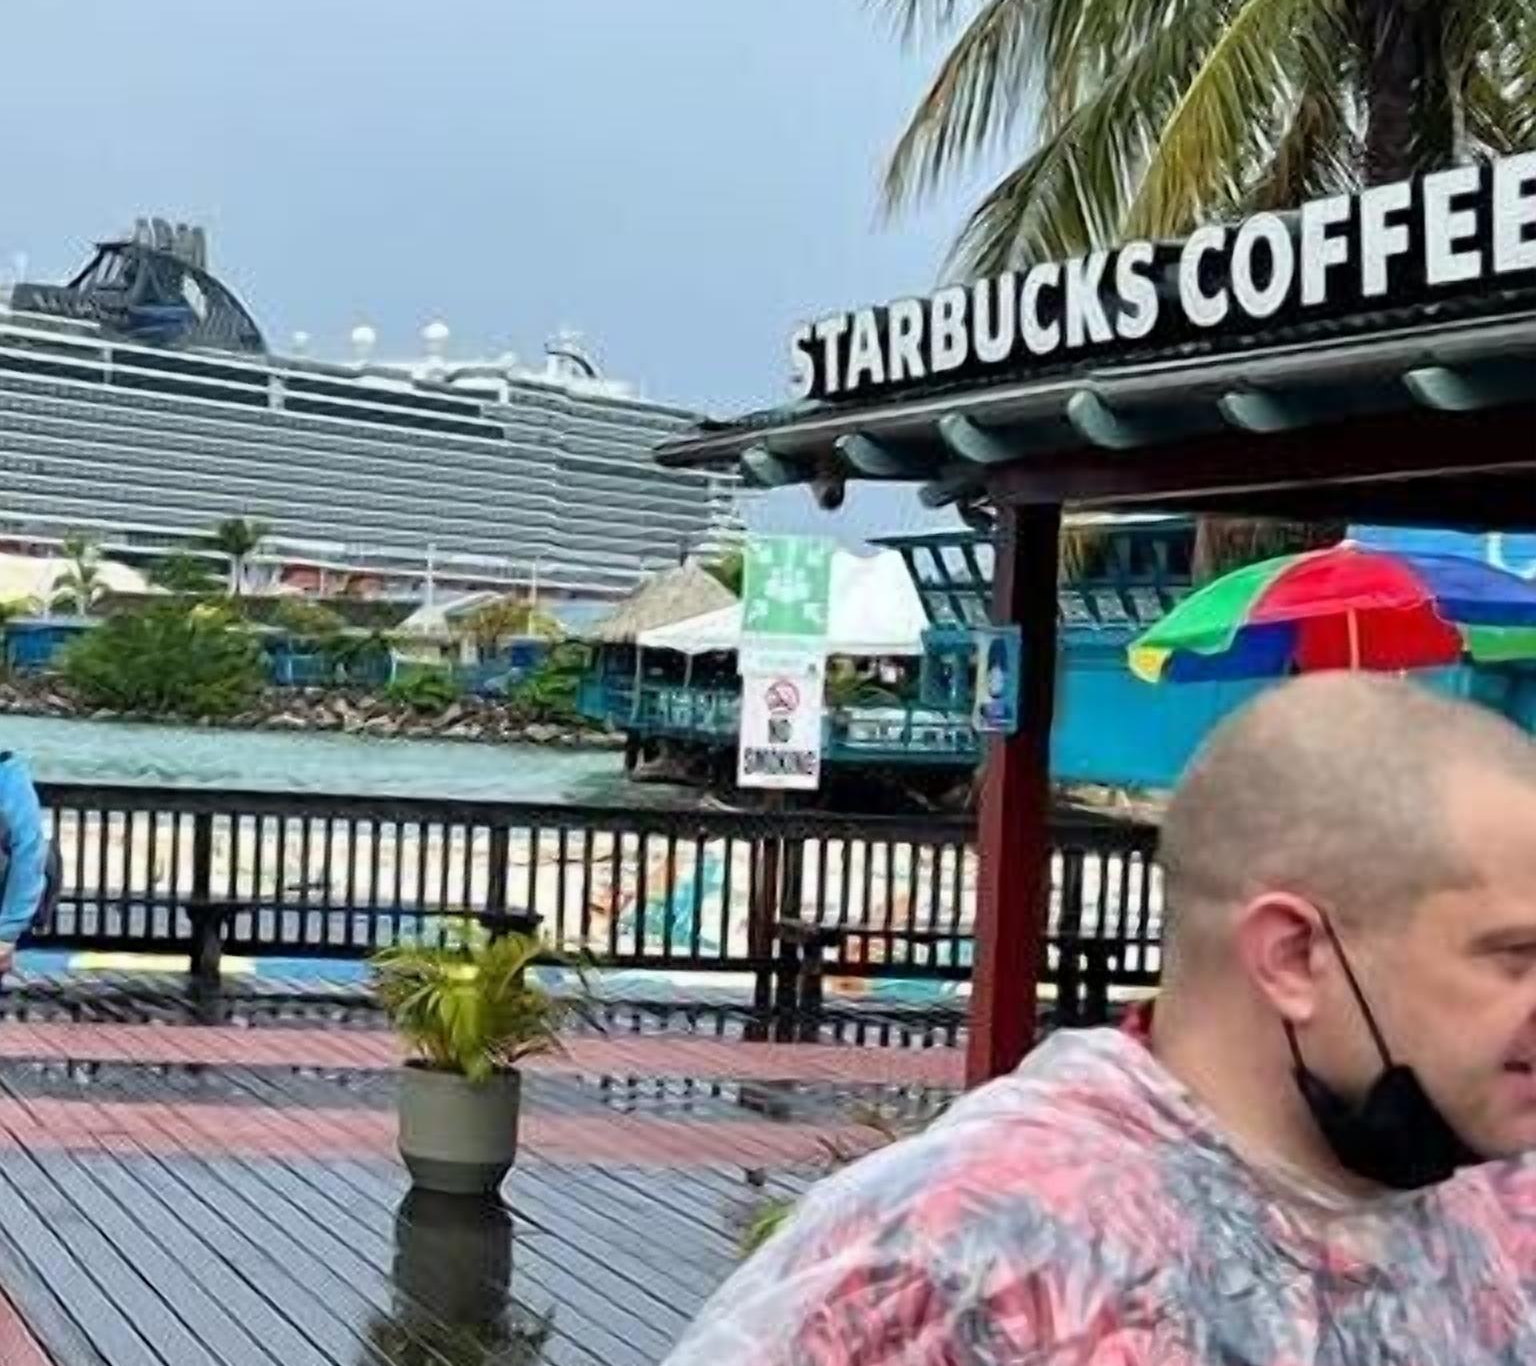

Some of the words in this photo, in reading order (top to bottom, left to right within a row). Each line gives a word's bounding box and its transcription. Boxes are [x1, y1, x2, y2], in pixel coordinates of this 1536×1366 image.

[789, 240, 1160, 398] STARBUCKS
[1178, 151, 1536, 328] COFFEE
[767, 718, 793, 744] NO
[744, 747, 817, 775] SMOKING
